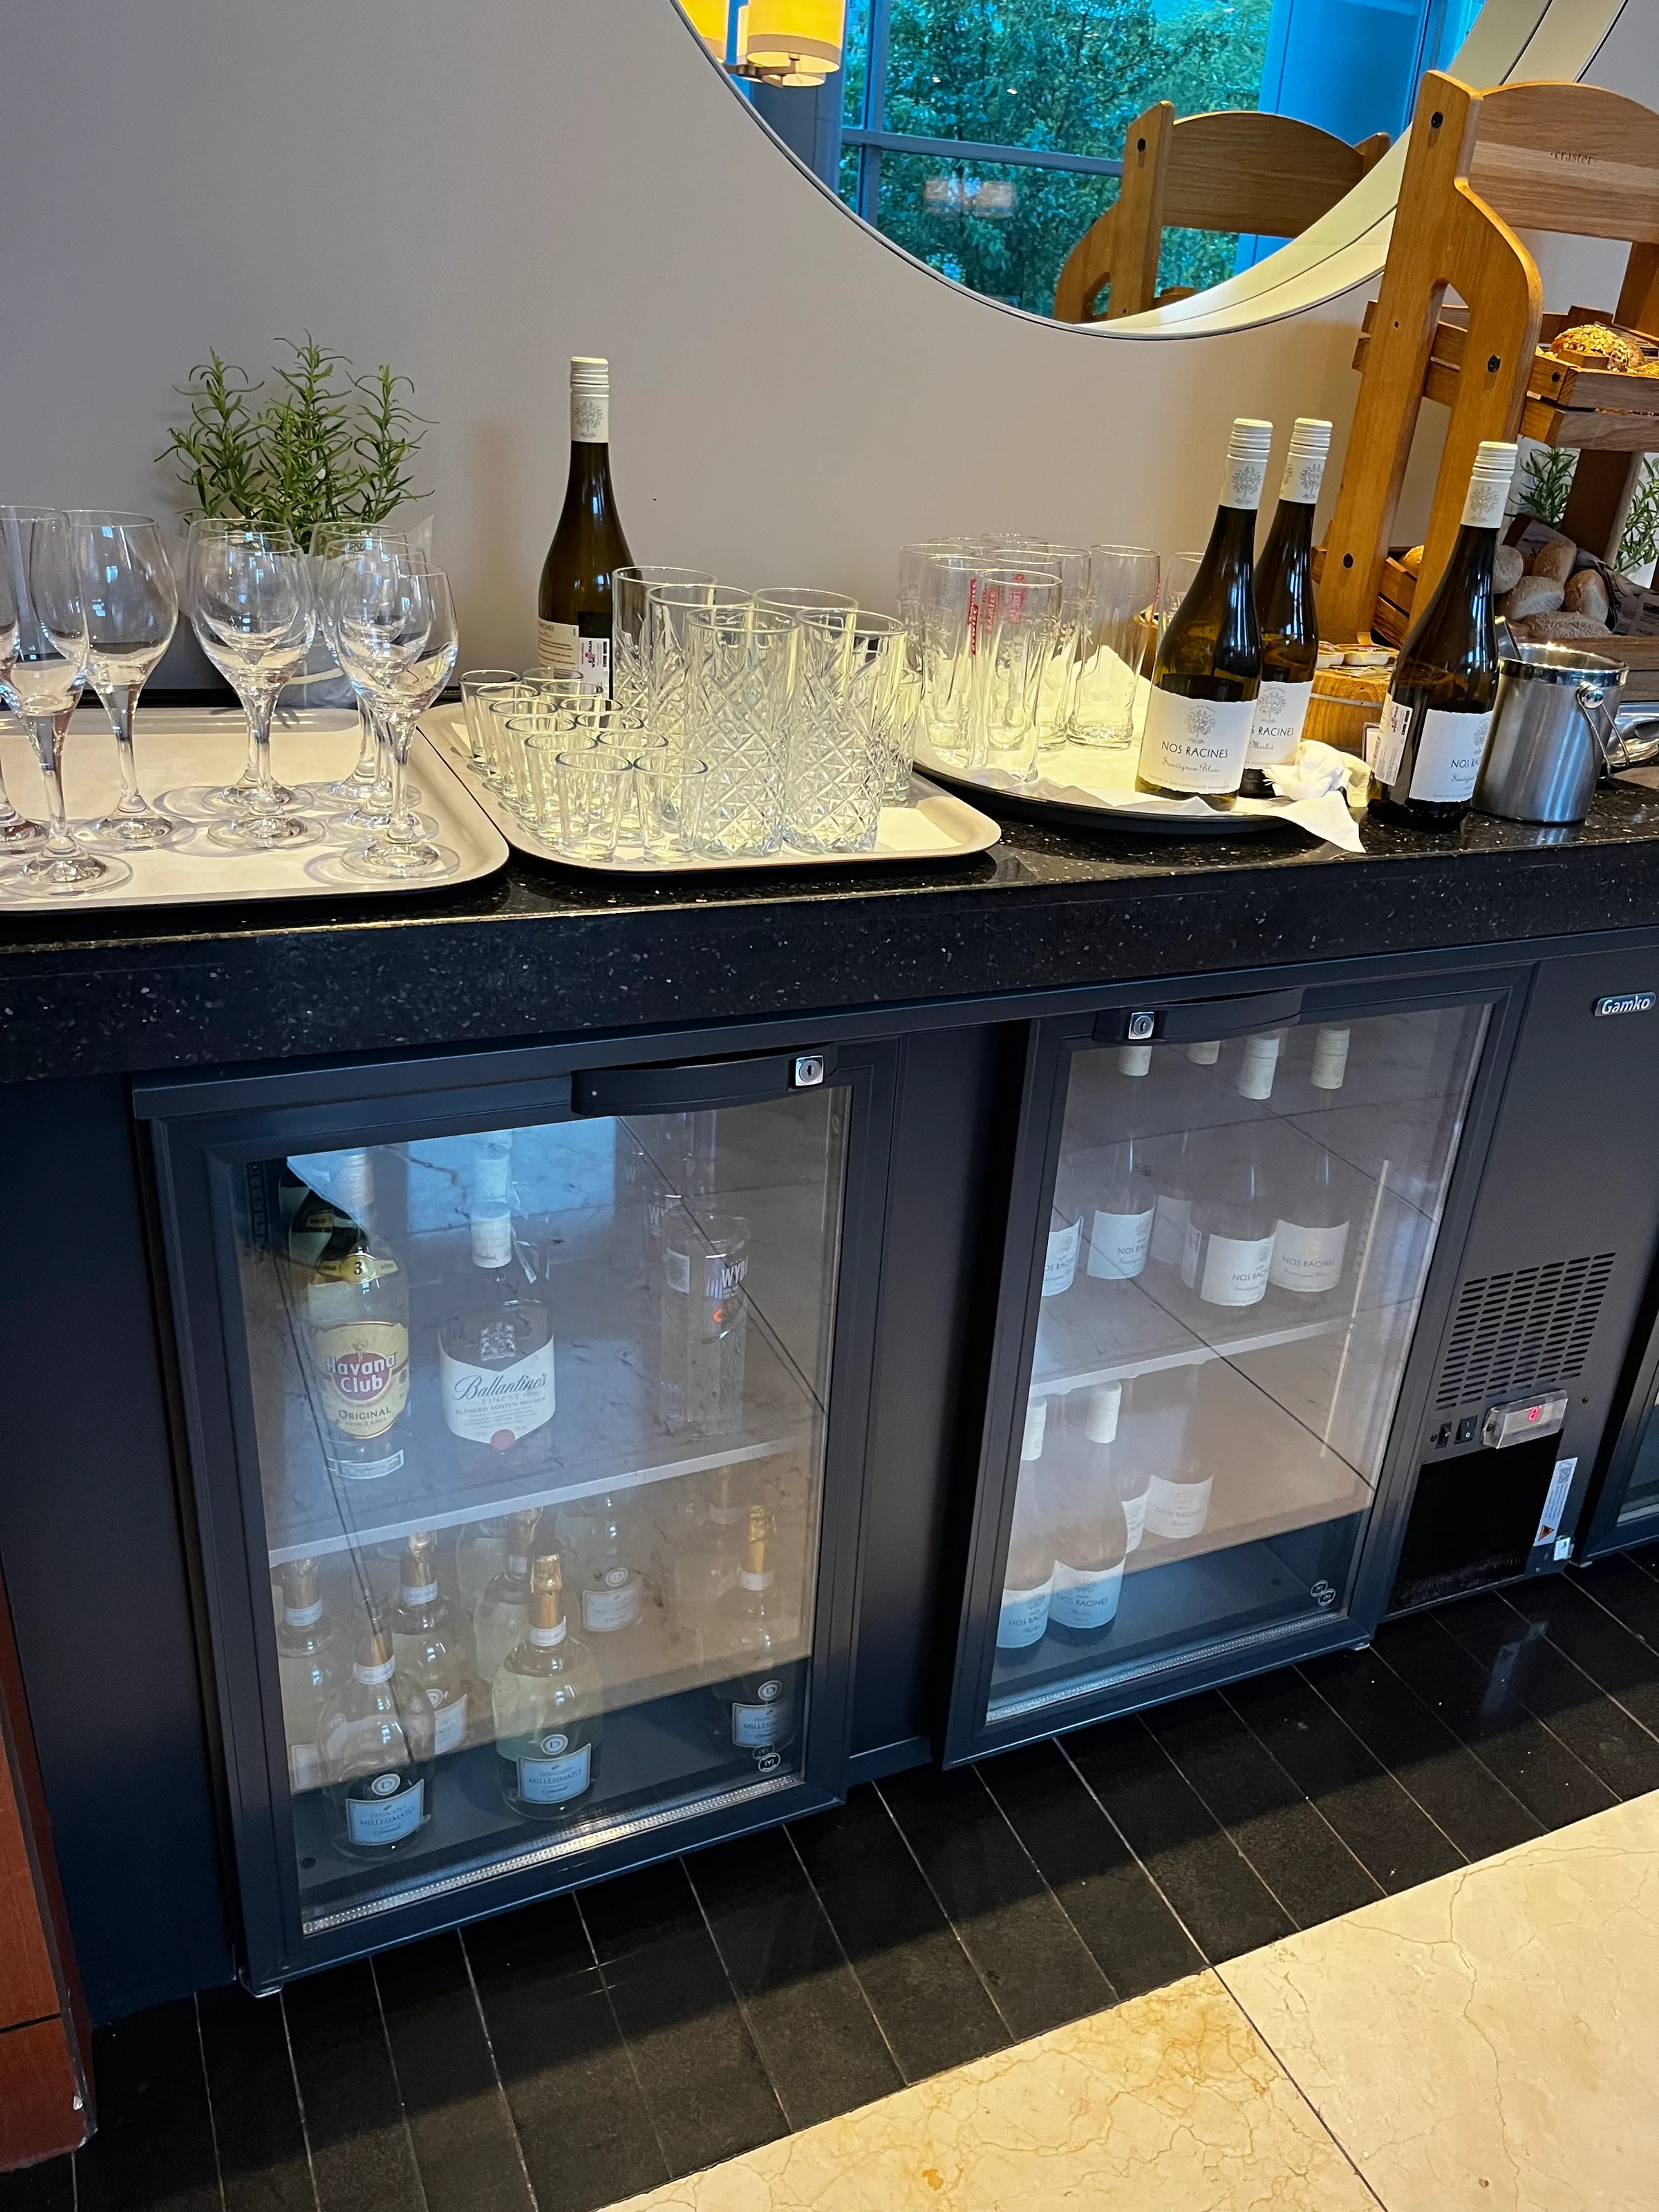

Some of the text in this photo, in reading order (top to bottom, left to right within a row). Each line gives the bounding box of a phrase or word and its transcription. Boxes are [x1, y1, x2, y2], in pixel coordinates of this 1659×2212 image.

[1258, 726, 1295, 736] RACINES
[1161, 740, 1229, 758] NOS RACINES
[1249, 740, 1274, 750] Merlot
[1162, 756, 1221, 773] Sauvignon Blanc
[1450, 759, 1470, 768] NOS
[1602, 995, 1651, 1015] Gamko
[1117, 1246, 1134, 1255] NOS
[1282, 1255, 1301, 1266] NOS
[353, 1262, 363, 1275] 3
[1044, 1264, 1054, 1272] OS
[326, 1352, 397, 1374] Havana
[340, 1374, 383, 1393] Club
[452, 1373, 547, 1401] Ballantine's
[455, 1396, 546, 1415] BLENDED SCOTCH WHISKY
[482, 1393, 520, 1405] FINEST
[338, 1406, 392, 1421] ORIGINAL
